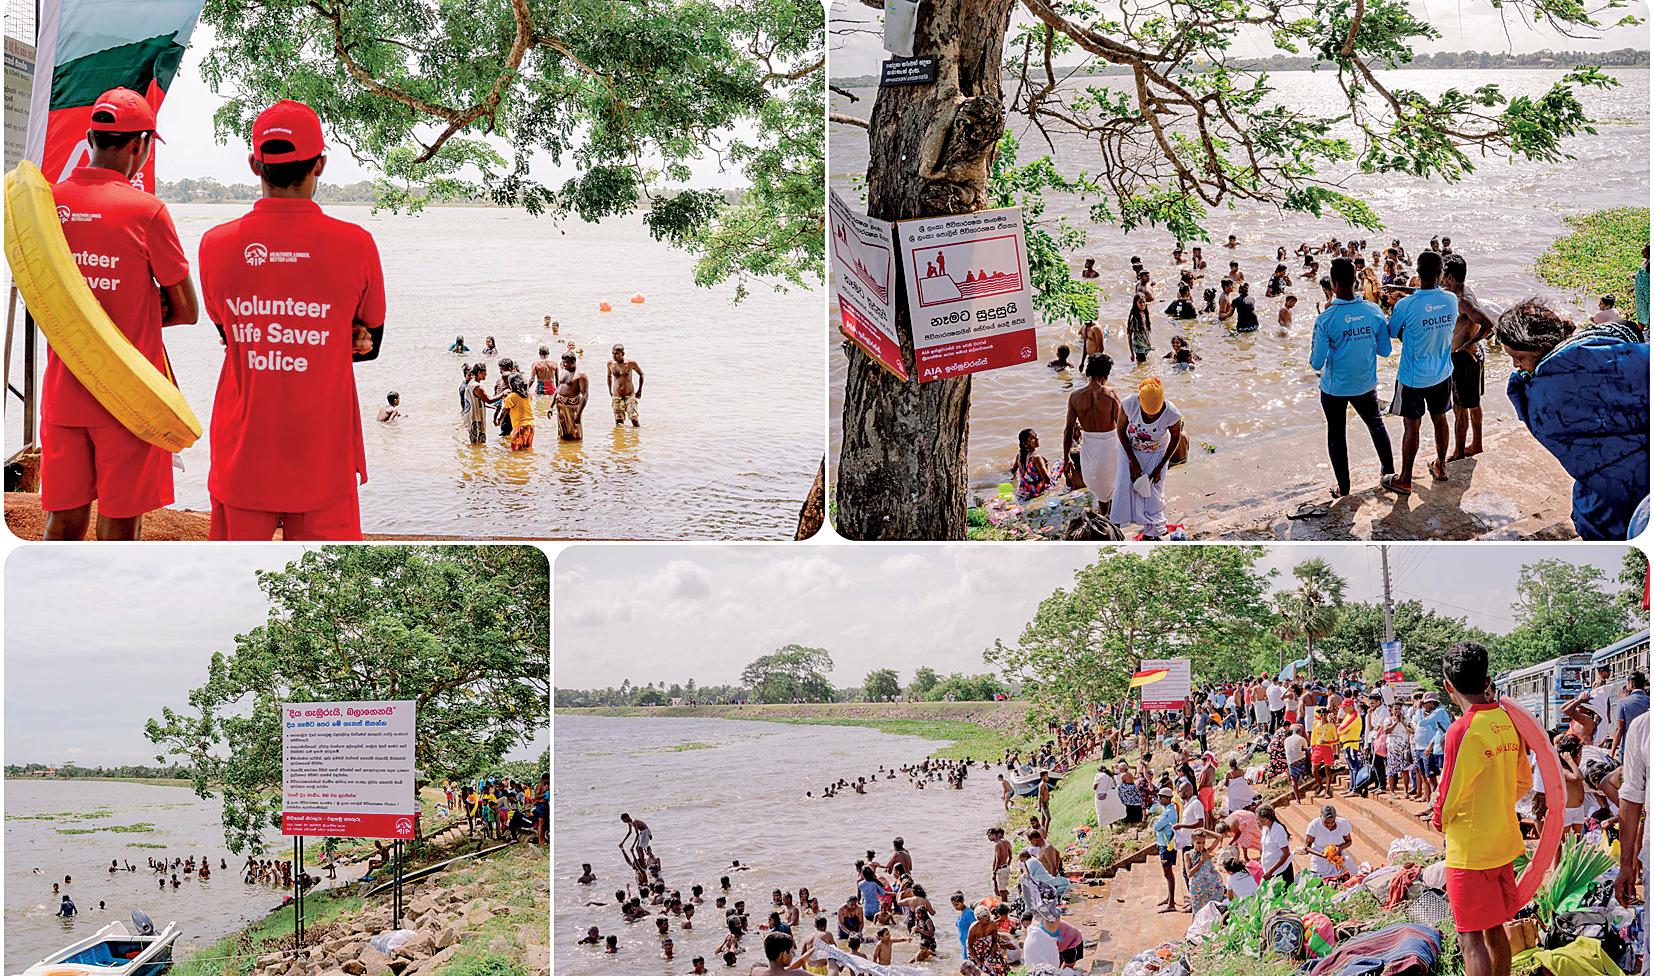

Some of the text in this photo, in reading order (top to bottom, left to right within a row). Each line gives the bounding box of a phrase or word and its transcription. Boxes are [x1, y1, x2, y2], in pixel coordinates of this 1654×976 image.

[927, 224, 944, 232] ලංකා
[226, 295, 331, 318] Volunteer
[930, 302, 1018, 326] නෑමට සුදුසුයි
[1422, 314, 1452, 326] POLICE
[266, 322, 330, 346] Saver
[1343, 326, 1371, 338] POLICE
[248, 350, 308, 372] Police
[924, 367, 942, 376] AIA
